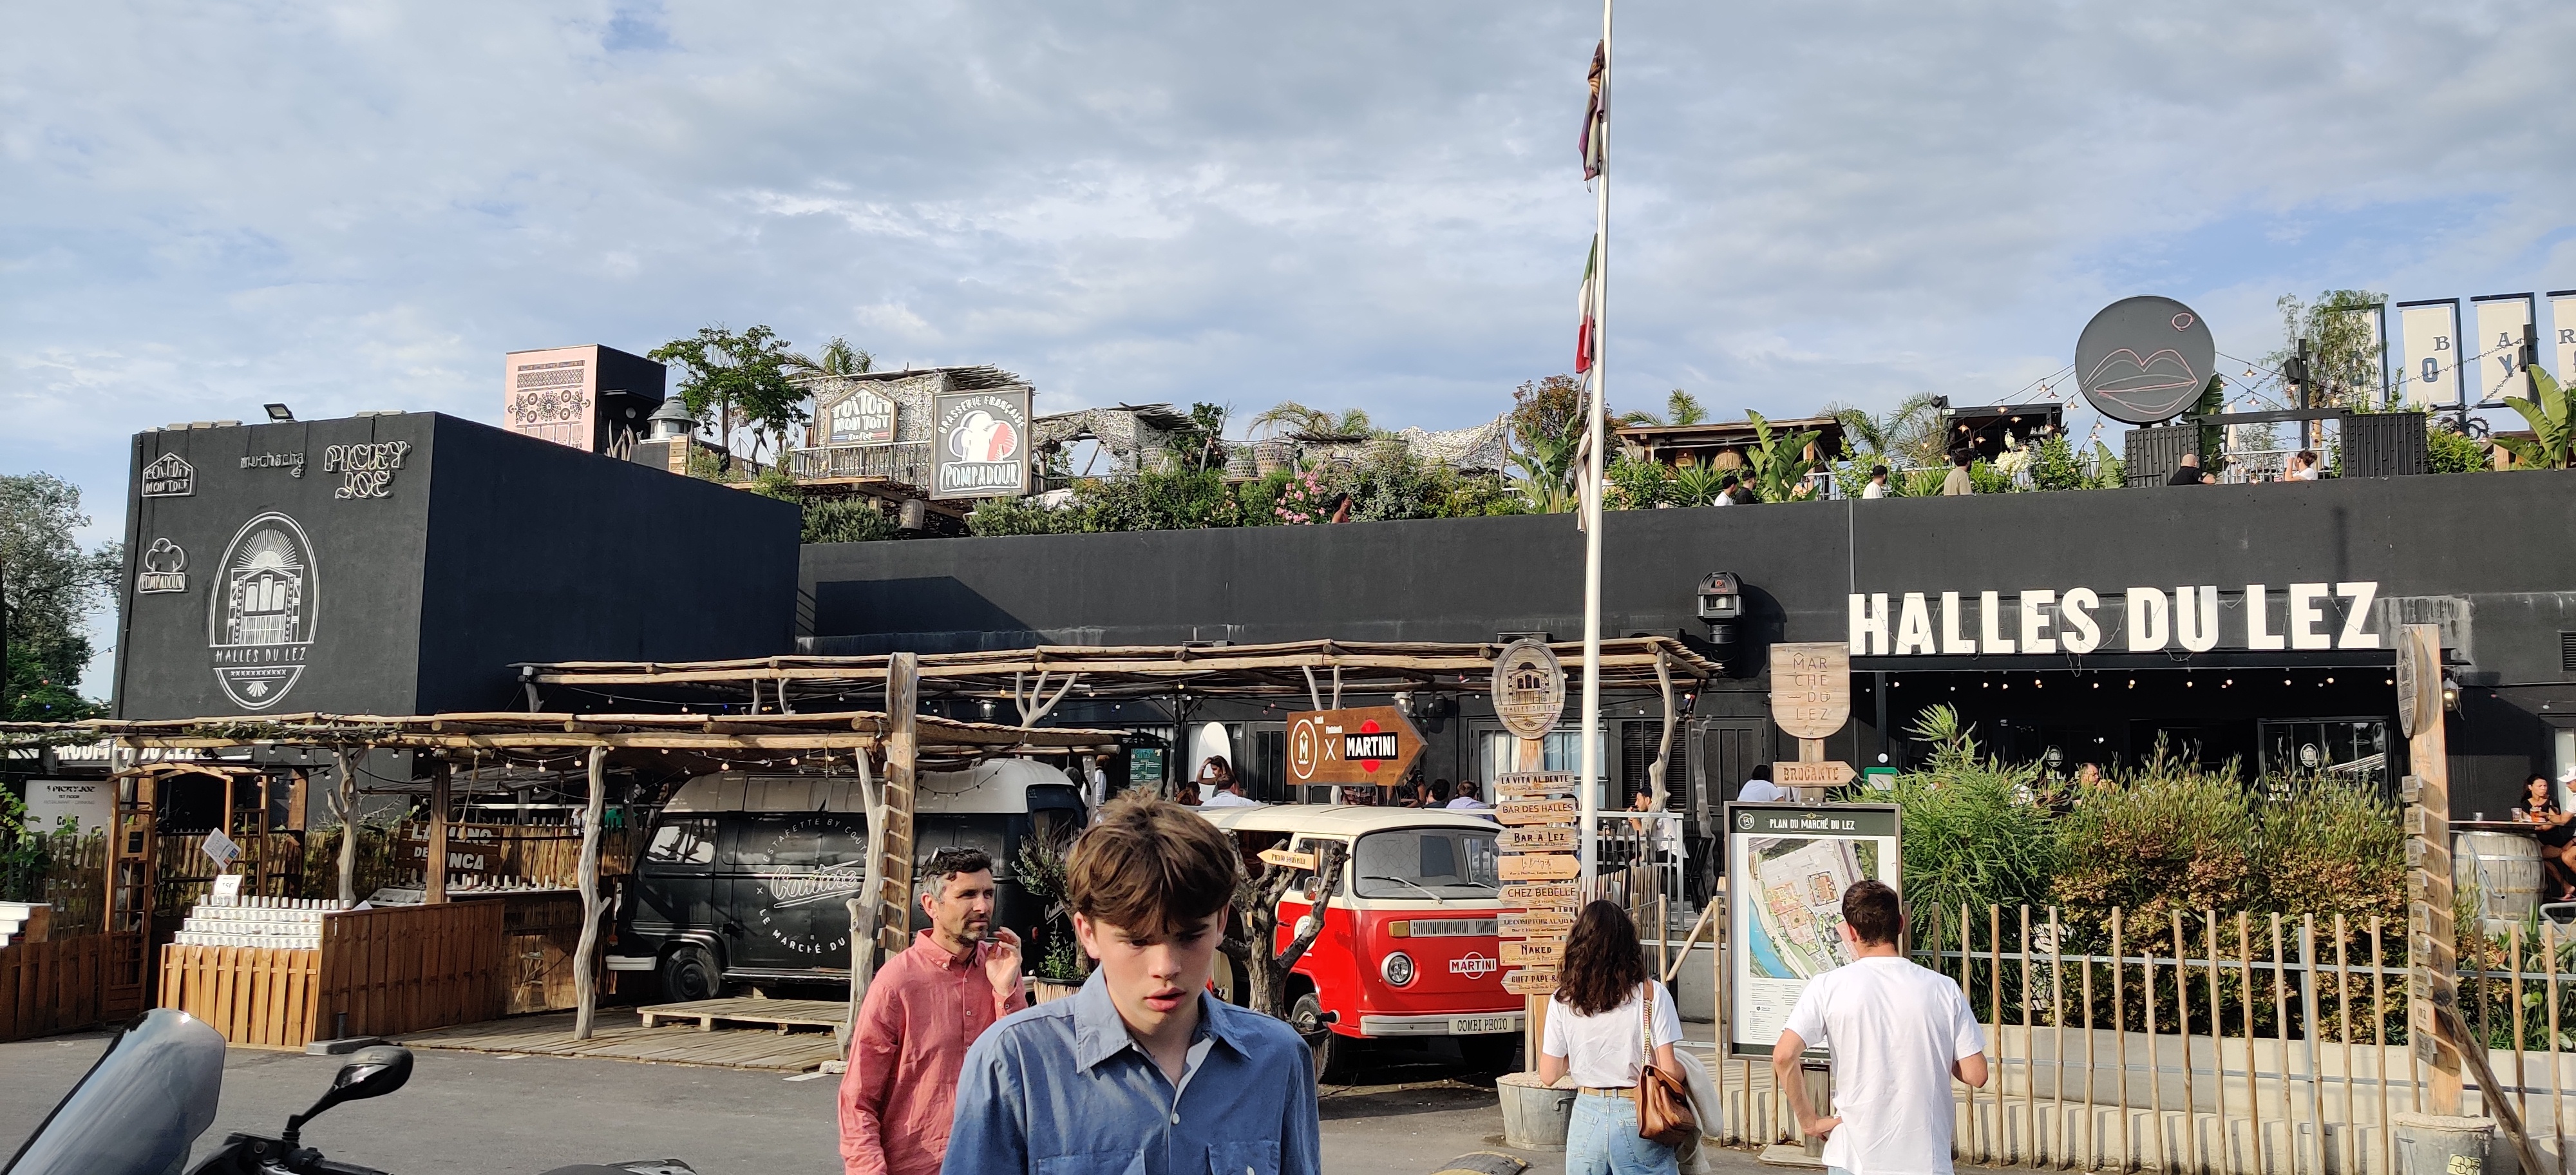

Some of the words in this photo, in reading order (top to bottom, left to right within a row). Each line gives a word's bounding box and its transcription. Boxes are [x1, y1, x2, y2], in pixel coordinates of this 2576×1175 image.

[938, 396, 982, 434] BRASSERIE
[984, 395, 1026, 430] FRANÇAISE
[324, 441, 411, 472] PICKY
[945, 463, 1018, 488] POMPADOUR
[334, 470, 391, 499] JOE
[142, 574, 183, 590] POMPADOUR
[1848, 587, 2101, 656] HALLES
[2126, 586, 2219, 653] DU
[2246, 582, 2380, 651] LEZ
[216, 649, 259, 663] HALLES
[265, 648, 279, 662] DU
[285, 647, 307, 661] LEZ
[1808, 691, 1828, 703] DU
[1796, 709, 1828, 720] LEZ
[1346, 736, 1396, 757] MARTINI
[1783, 767, 1839, 781] BROCANTE
[827, 818, 840, 827] BY
[1769, 818, 1788, 829] PLAN
[1790, 819, 1799, 829] DU
[1801, 817, 1829, 830] MARCHÉ
[1831, 819, 1839, 830] DU
[1842, 819, 1855, 830] LEZ
[1535, 888, 1576, 897] BEBELLE
[759, 908, 771, 925] LE
[829, 937, 846, 951] DU
[1452, 960, 1495, 971] MARTINI
[1457, 1019, 1482, 1031] COMBI
[1484, 1018, 1508, 1031] PHOTO
